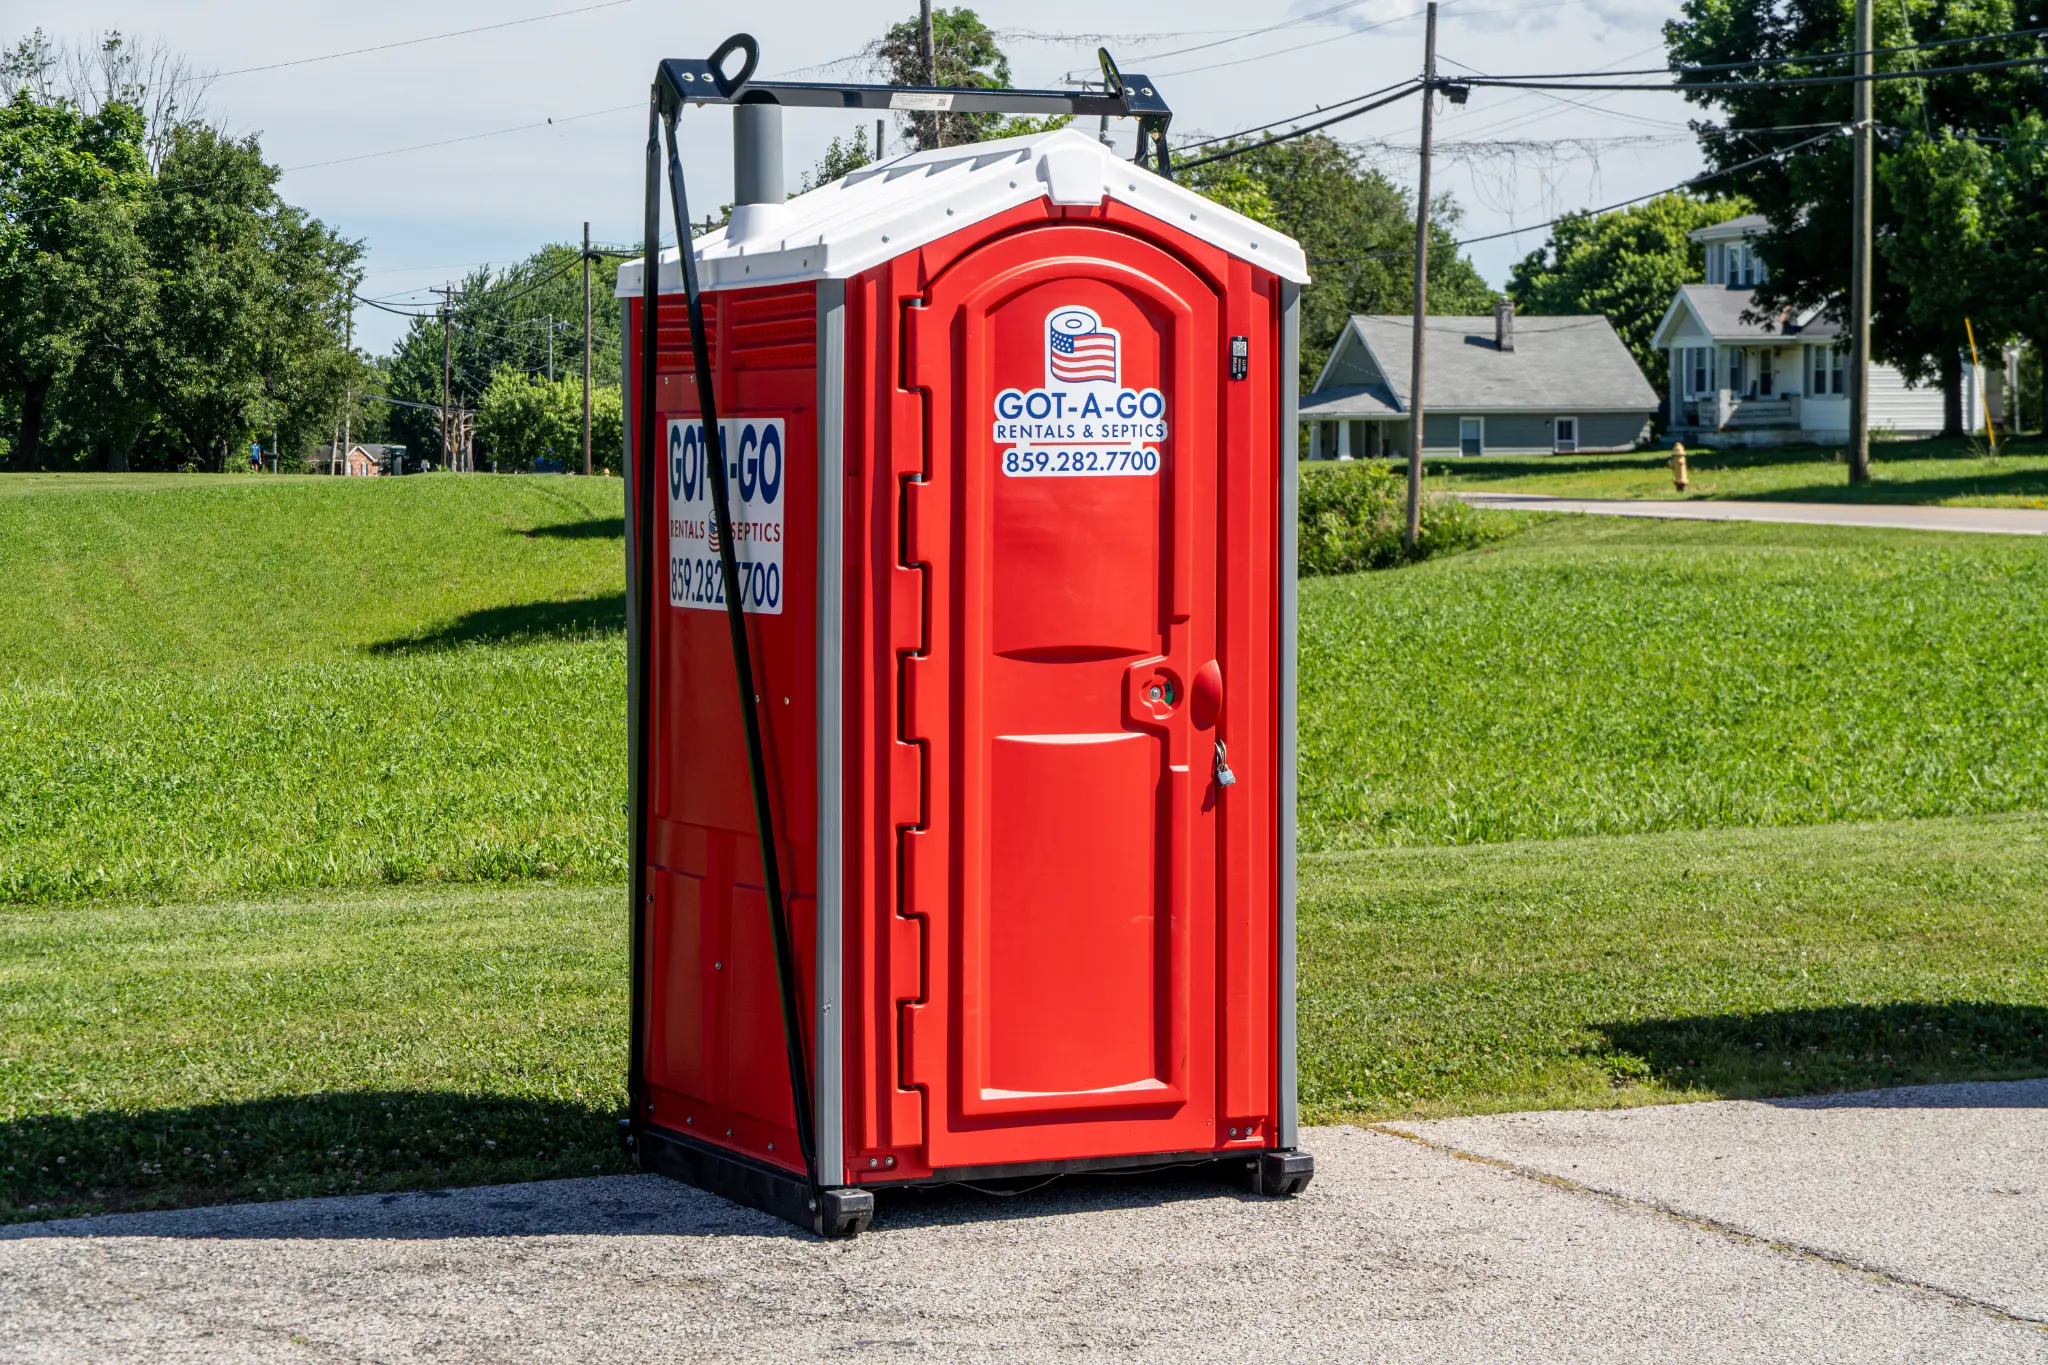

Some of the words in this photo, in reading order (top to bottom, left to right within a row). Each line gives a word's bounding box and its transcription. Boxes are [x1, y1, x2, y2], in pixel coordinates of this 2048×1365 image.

[998, 392, 1163, 419] GOT-A-GO
[997, 424, 1075, 438] RENTALS
[1083, 424, 1094, 438] &
[1101, 423, 1164, 438] SEPTICS
[1006, 451, 1157, 472] 859.282.7700
[670, 519, 705, 540] RENTALS
[731, 521, 781, 543] SEPTICS
[671, 557, 780, 608] 859.282700
